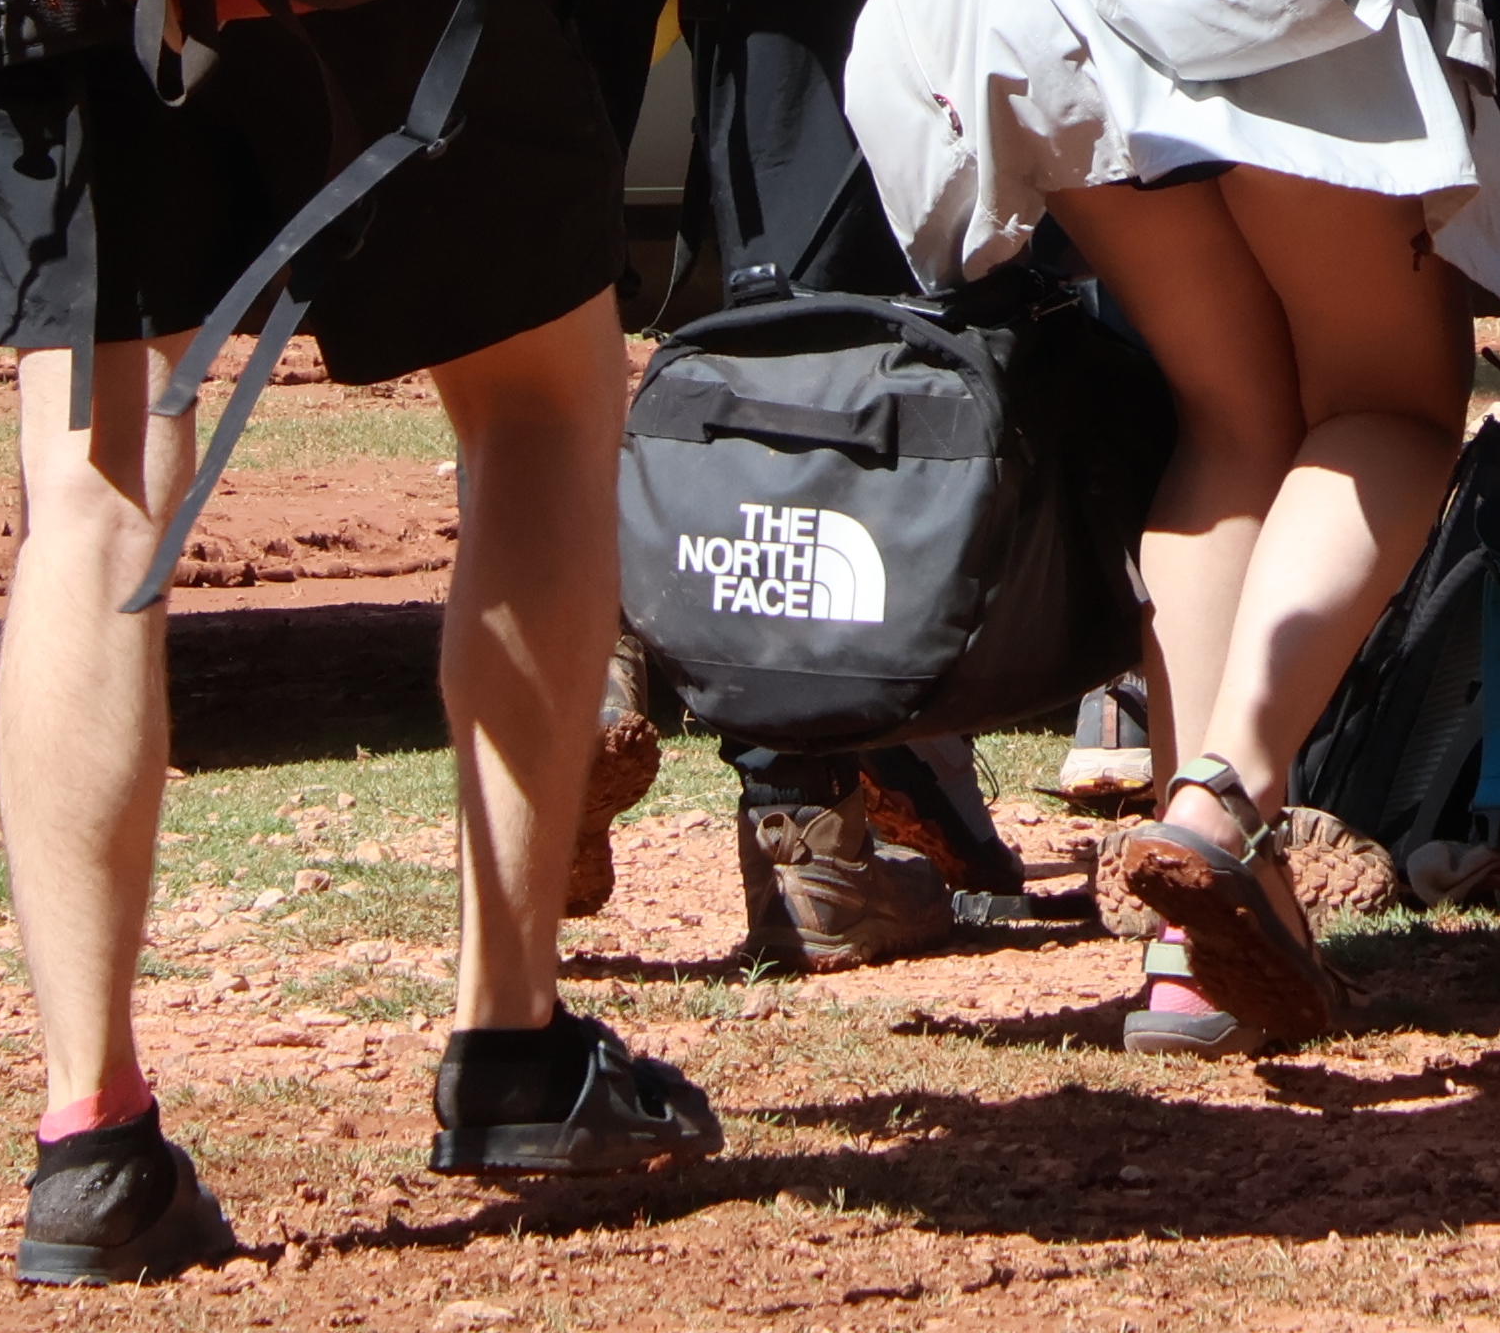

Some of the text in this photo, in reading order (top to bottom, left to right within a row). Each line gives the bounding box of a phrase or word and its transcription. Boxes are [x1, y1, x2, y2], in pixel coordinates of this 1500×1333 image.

[739, 502, 818, 546] THE
[677, 533, 815, 582] NORTH
[712, 574, 811, 620] FACE
